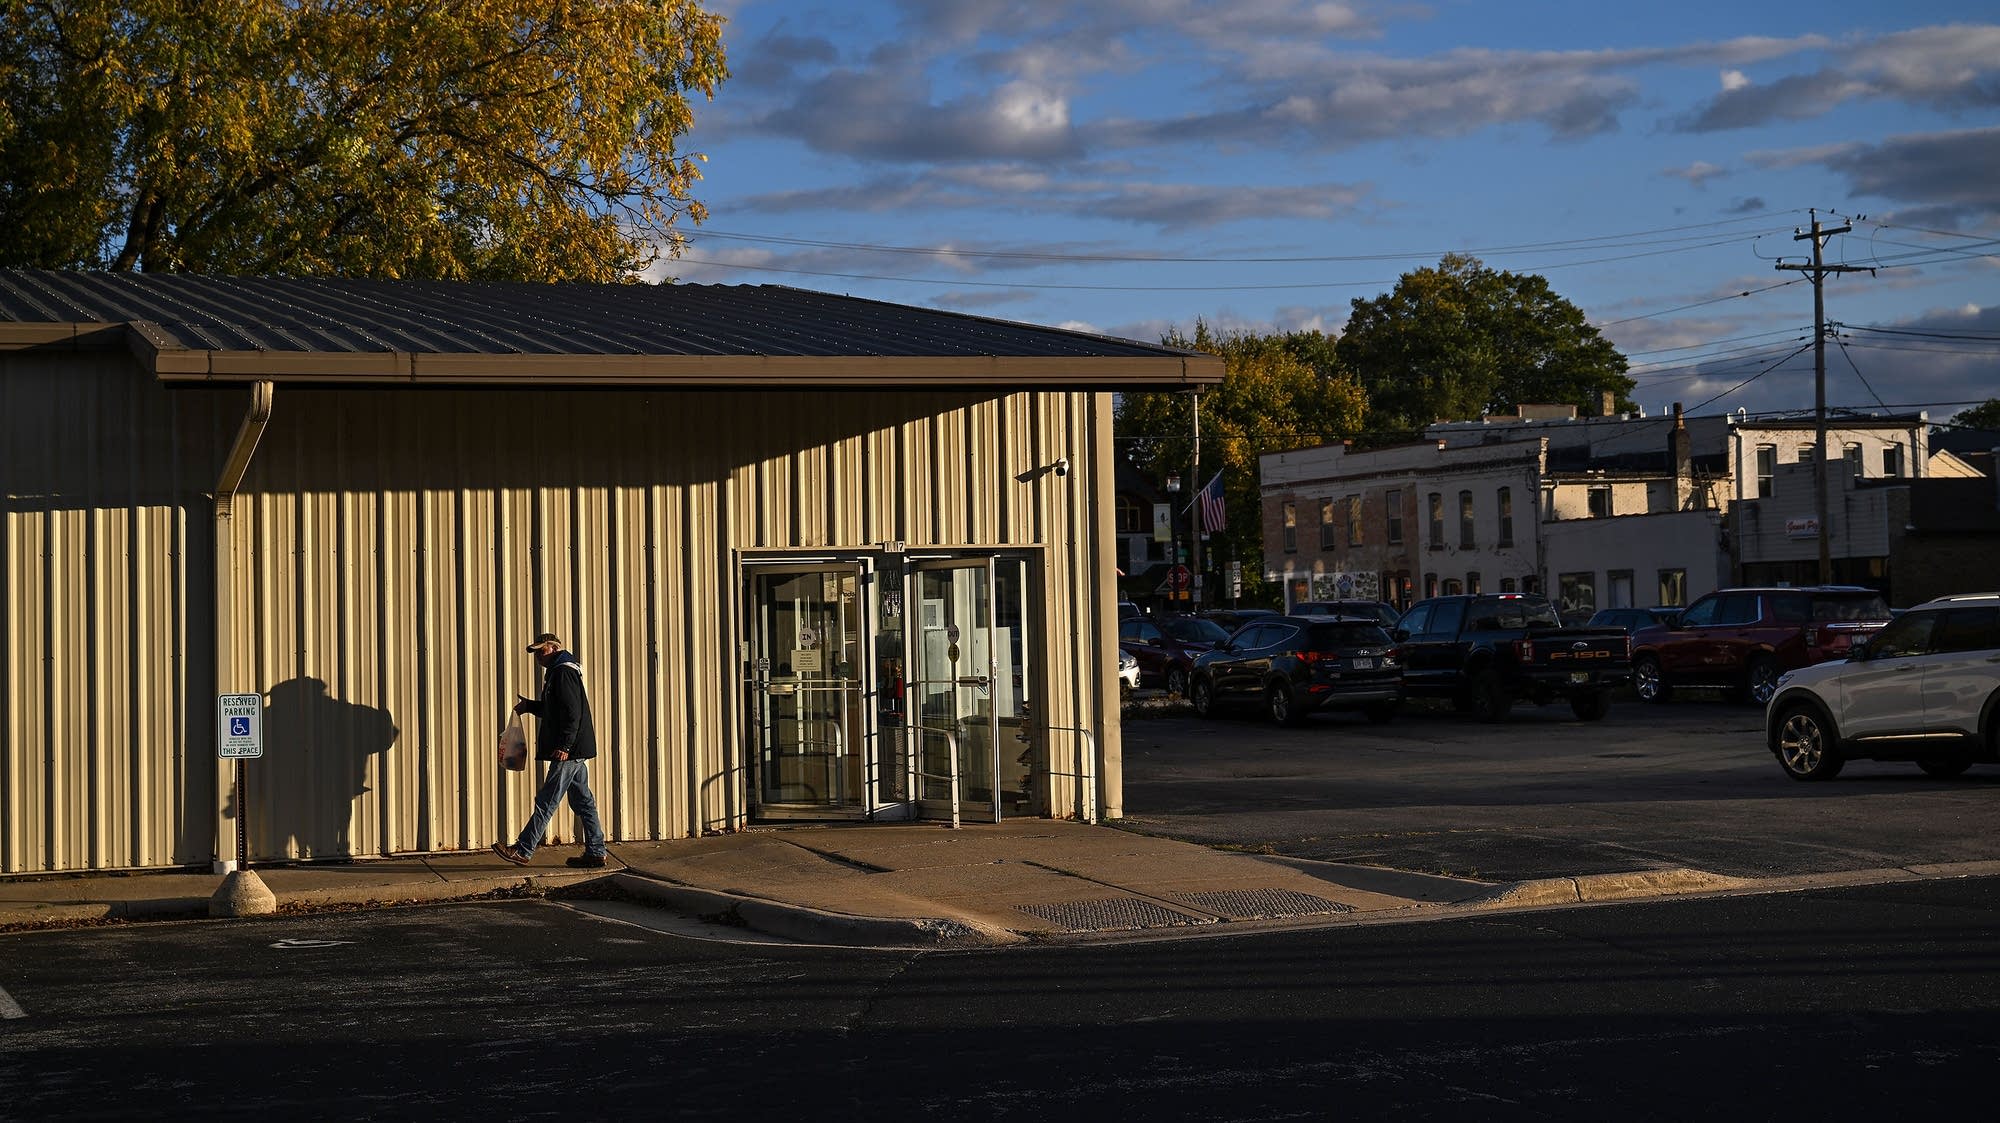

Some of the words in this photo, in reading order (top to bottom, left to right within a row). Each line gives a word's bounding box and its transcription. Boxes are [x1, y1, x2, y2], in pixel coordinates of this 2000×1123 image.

[1168, 572, 1188, 583] SOP
[802, 633, 812, 641] IN
[1551, 650, 1610, 660] F-150
[223, 697, 257, 706] RESERVED
[224, 707, 256, 716] PARKING
[223, 747, 237, 755] THIS
[238, 746, 258, 754] SPACE
